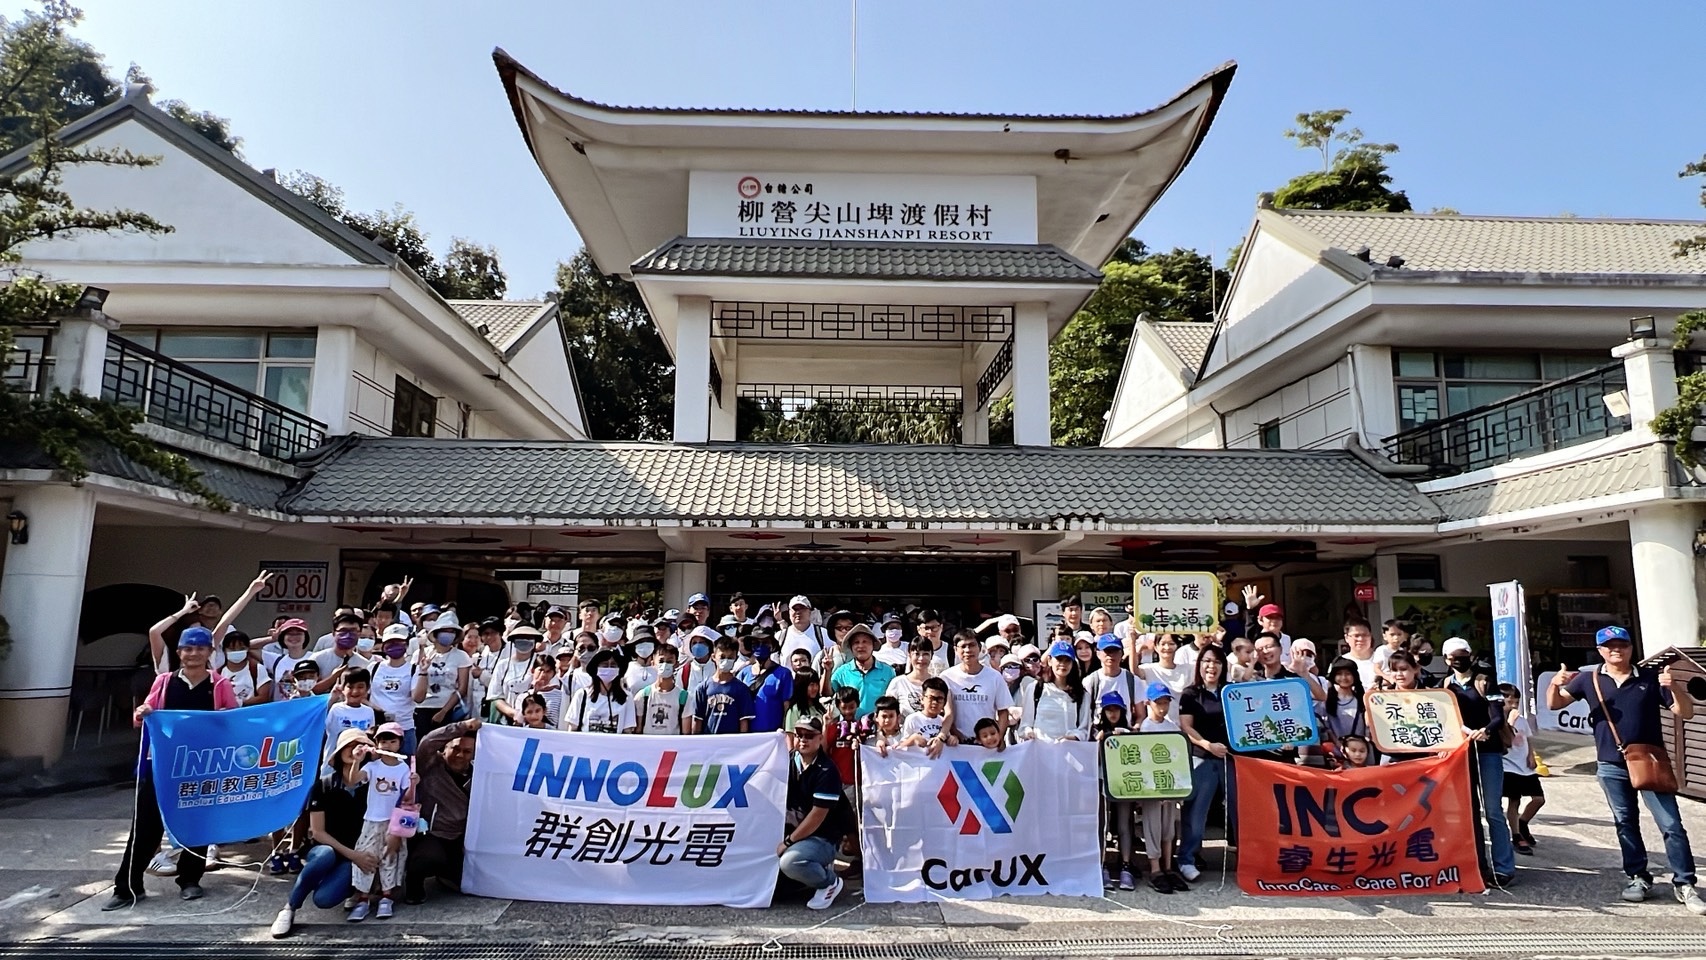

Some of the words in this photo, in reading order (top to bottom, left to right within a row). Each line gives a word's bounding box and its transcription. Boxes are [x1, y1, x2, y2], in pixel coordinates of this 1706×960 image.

[737, 200, 992, 226] 柳營尖山埤渡假村
[739, 227, 812, 238] LIUYING
[819, 228, 921, 240] JIANSHANPI
[928, 230, 993, 241] RESORT
[295, 574, 321, 599] 80
[1152, 583, 1199, 600] 低碳
[1094, 595, 1119, 604] 10/19
[1153, 607, 1199, 624] 生活
[1385, 702, 1437, 720] 永續
[1244, 718, 1297, 740] 環境
[1390, 726, 1444, 744] 環保
[1122, 769, 1175, 792] 行動
[524, 811, 735, 867] 群創光電
[1277, 827, 1439, 874] 睿生光電
[921, 853, 1049, 892] CarUX
[1354, 876, 1397, 890] Care
[1400, 873, 1432, 889] For
[1437, 867, 1459, 885] All
